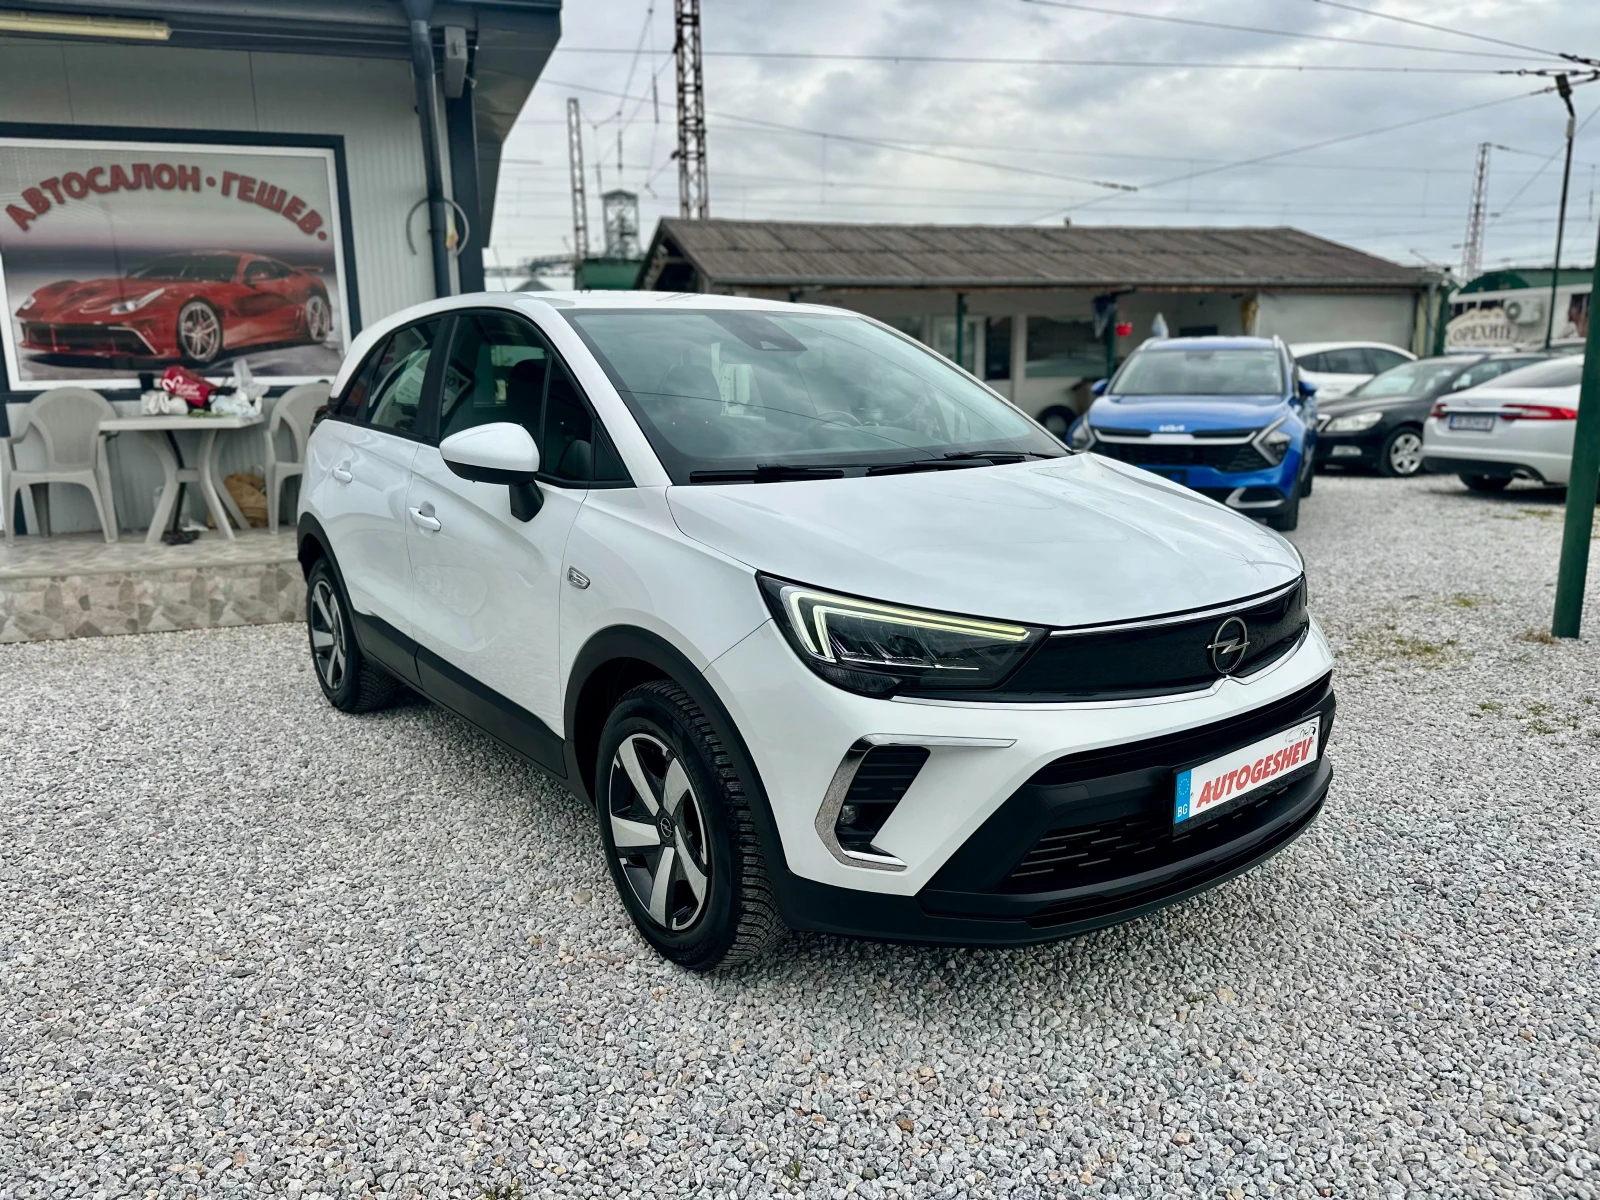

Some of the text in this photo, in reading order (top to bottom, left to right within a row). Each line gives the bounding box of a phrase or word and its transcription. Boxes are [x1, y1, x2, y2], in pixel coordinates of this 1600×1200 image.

[5, 163, 200, 231] АВТОСАЛОН
[1196, 737, 1313, 808] AUTOGESHEV
[1177, 803, 1188, 818] BG
